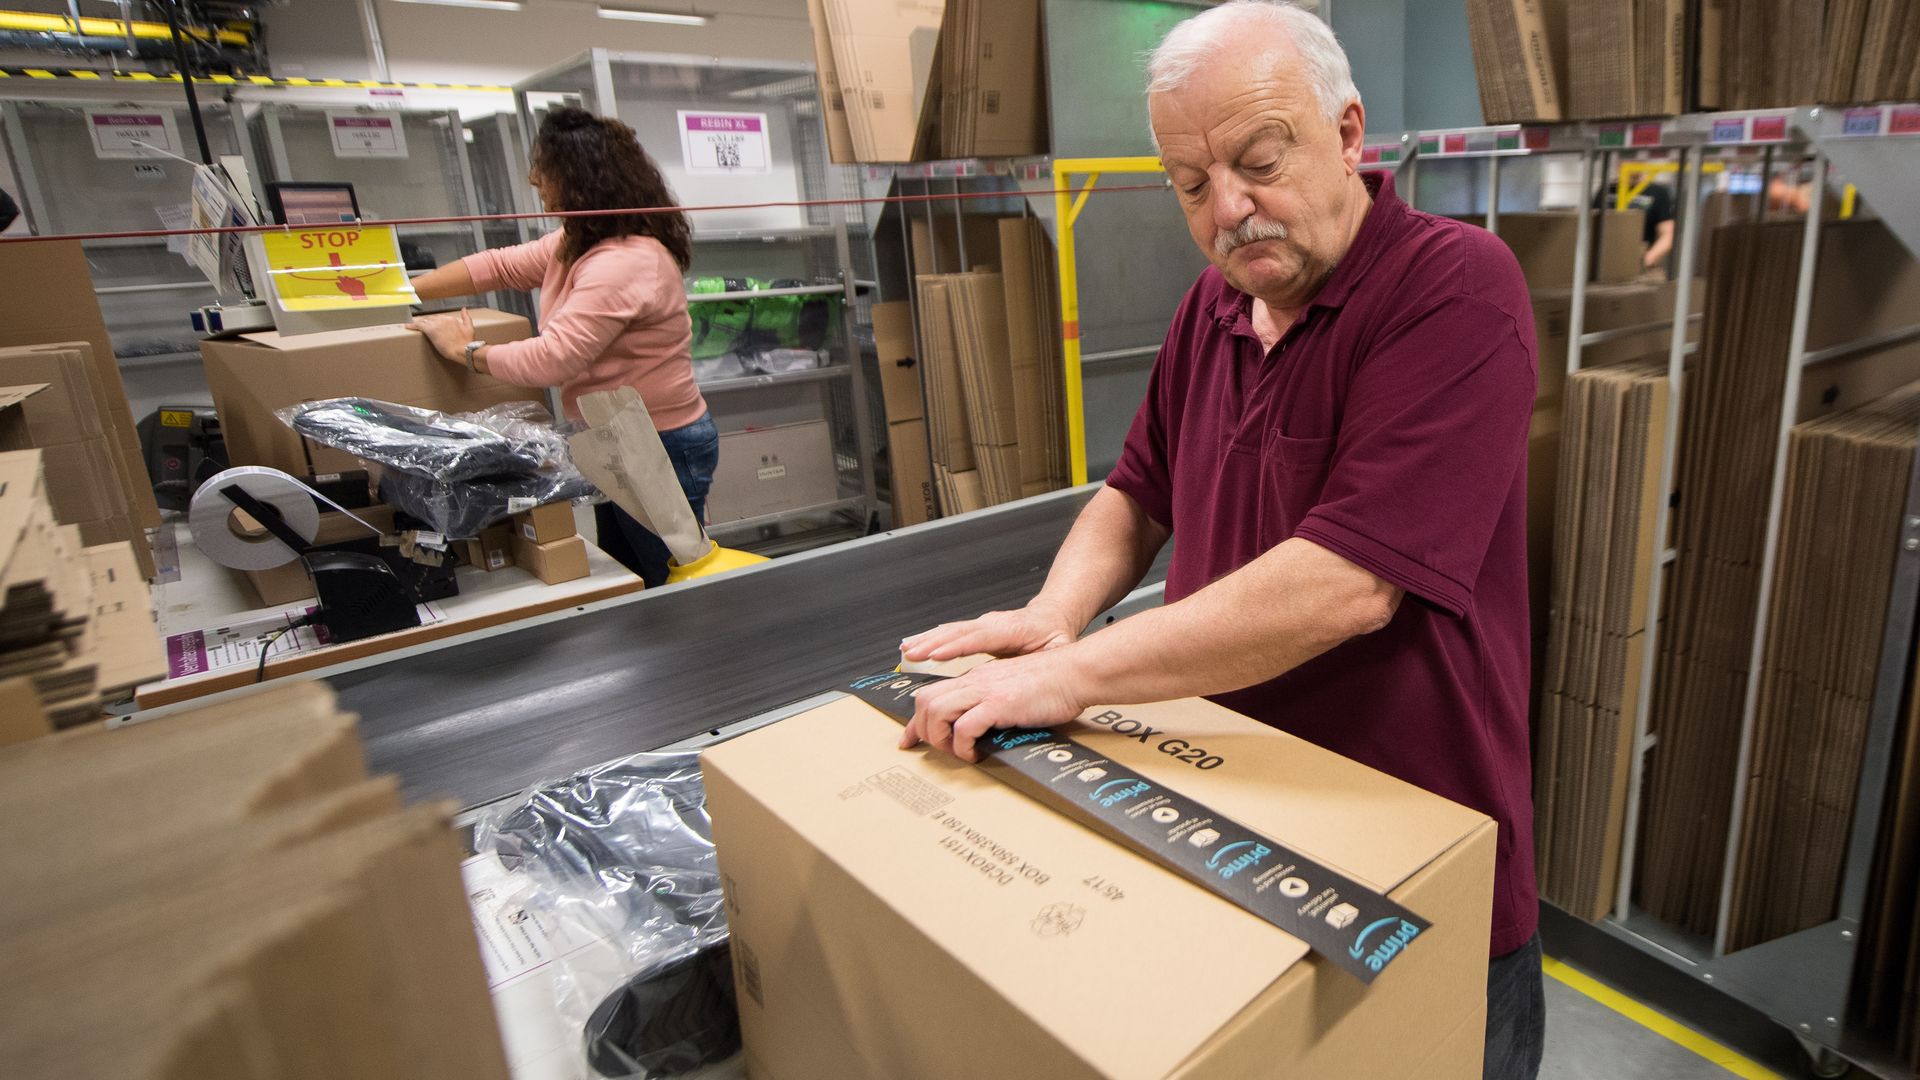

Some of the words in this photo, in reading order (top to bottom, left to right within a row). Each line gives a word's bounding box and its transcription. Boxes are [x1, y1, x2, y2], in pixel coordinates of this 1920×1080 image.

[700, 118, 732, 129] REBIN
[735, 118, 747, 129] XL
[300, 231, 360, 249] STOP
[1091, 710, 1164, 744] BOX
[1157, 739, 1224, 770] G20
[1099, 780, 1151, 808] prime
[1016, 861, 1050, 886] BOX
[1218, 842, 1271, 879] prime
[1364, 919, 1420, 972] prime
